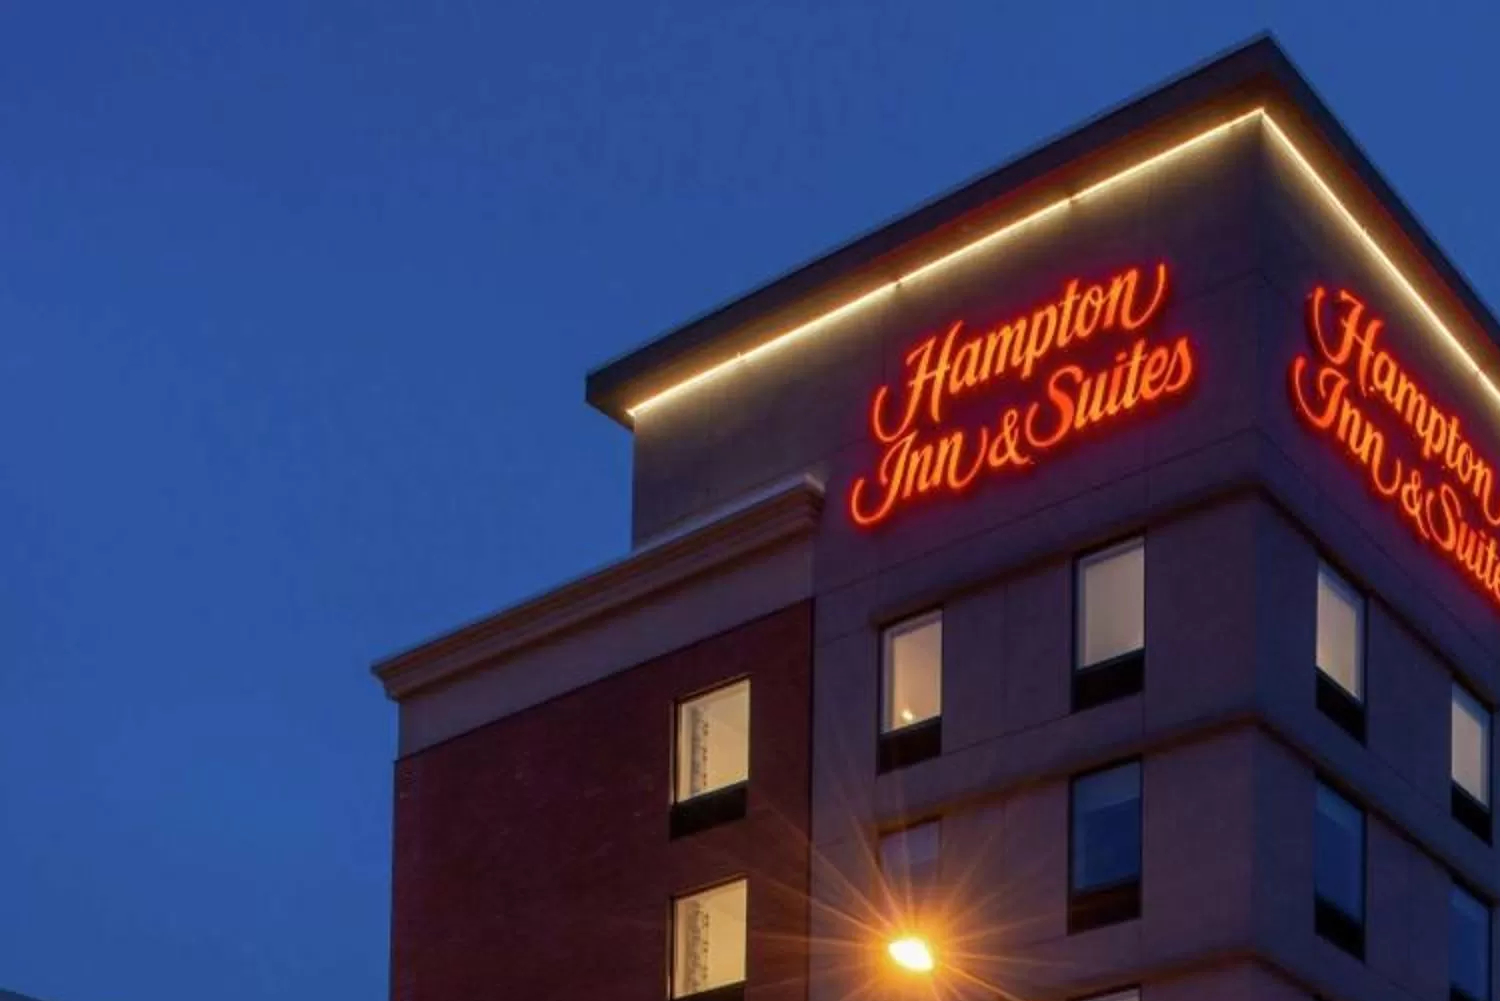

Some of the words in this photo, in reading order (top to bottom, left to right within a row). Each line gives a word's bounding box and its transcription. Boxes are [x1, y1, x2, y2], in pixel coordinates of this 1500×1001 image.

[851, 426, 989, 525] Inn
[987, 407, 1034, 468] &
[1024, 336, 1193, 448] Suites
[872, 263, 1166, 443] Hampton
[1294, 355, 1402, 496] Inn
[1401, 468, 1430, 540] &
